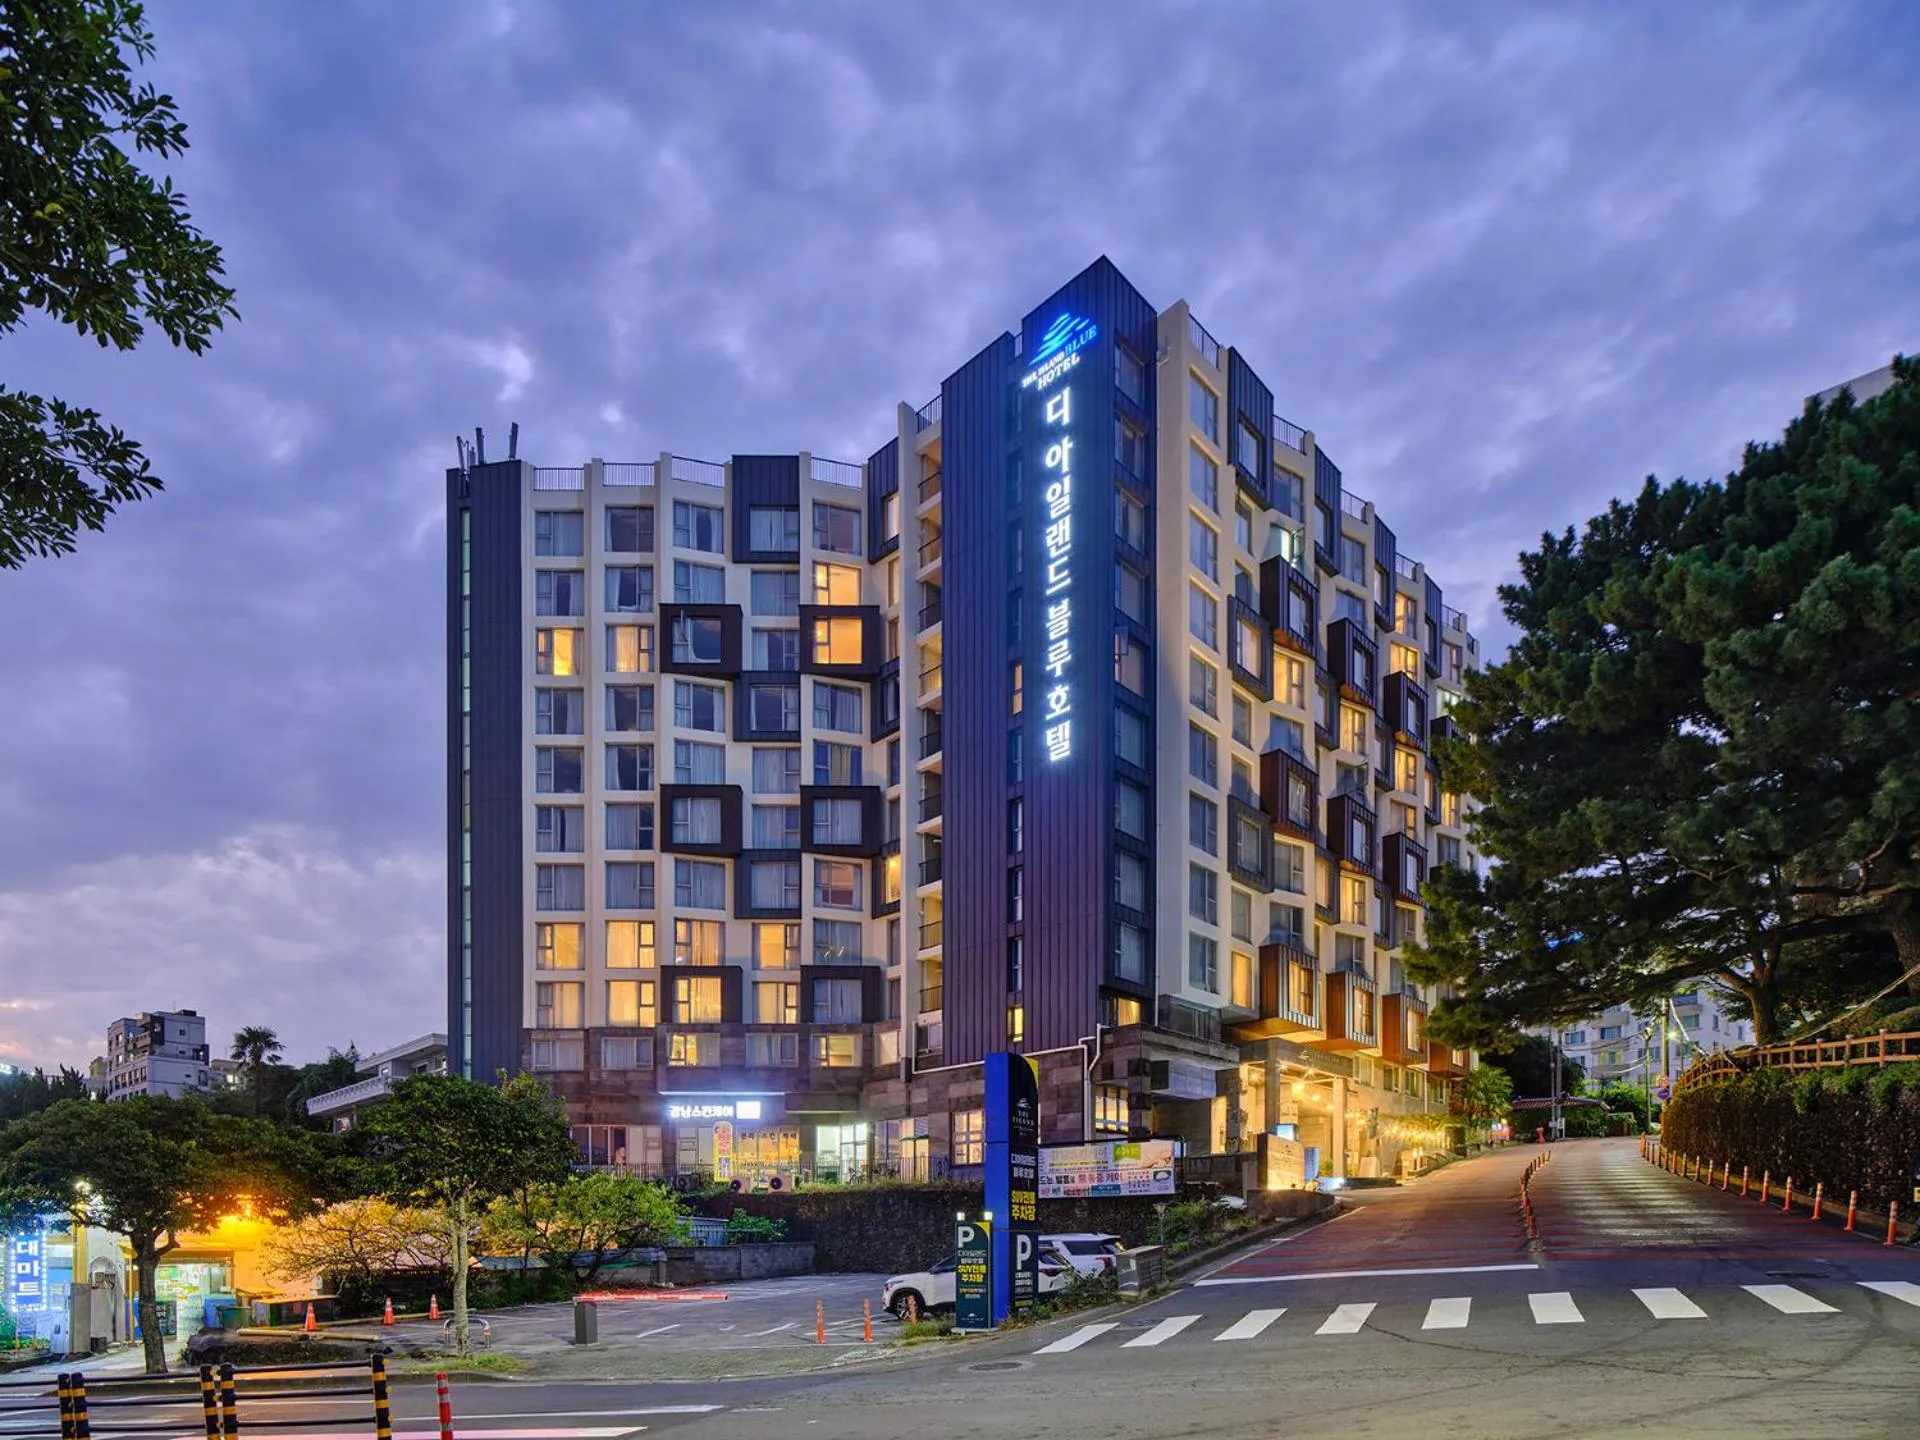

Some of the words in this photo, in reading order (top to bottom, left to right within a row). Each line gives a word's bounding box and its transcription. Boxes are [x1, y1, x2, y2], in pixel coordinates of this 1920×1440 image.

[1065, 325, 1097, 355] BLUE
[1037, 352, 1080, 390] HOTEL
[1012, 1204, 1036, 1221] 주차장
[958, 1226, 975, 1248] P
[1016, 1234, 1032, 1270] P
[961, 1273, 984, 1283] 주차장
